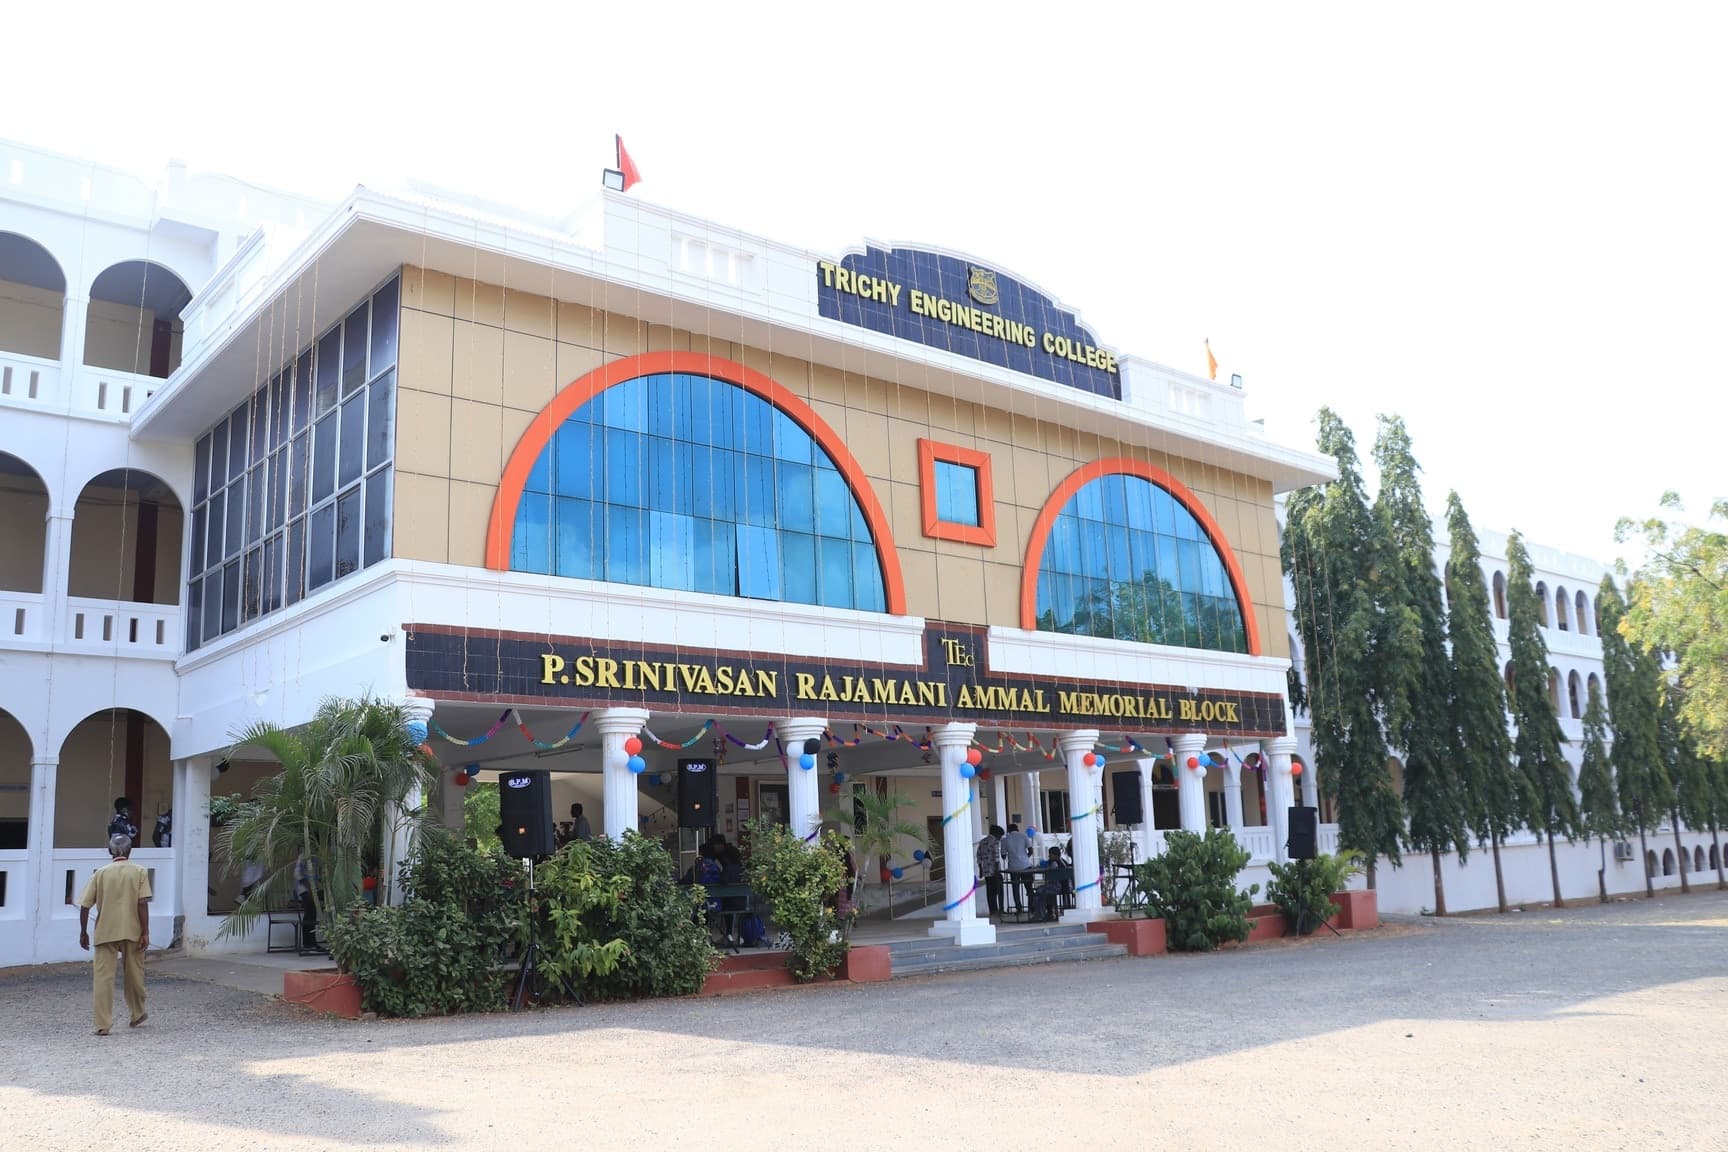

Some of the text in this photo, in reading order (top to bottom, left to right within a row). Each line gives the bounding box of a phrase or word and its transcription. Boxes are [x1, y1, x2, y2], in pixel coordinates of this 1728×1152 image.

[819, 262, 1118, 373] TRICHY ENGINEERING COLLEGE
[796, 672, 948, 707] RAJAMANI
[957, 684, 1050, 713] AMMAL
[1058, 691, 1173, 720] MEMORIAL
[1179, 700, 1239, 723] BLOCK
